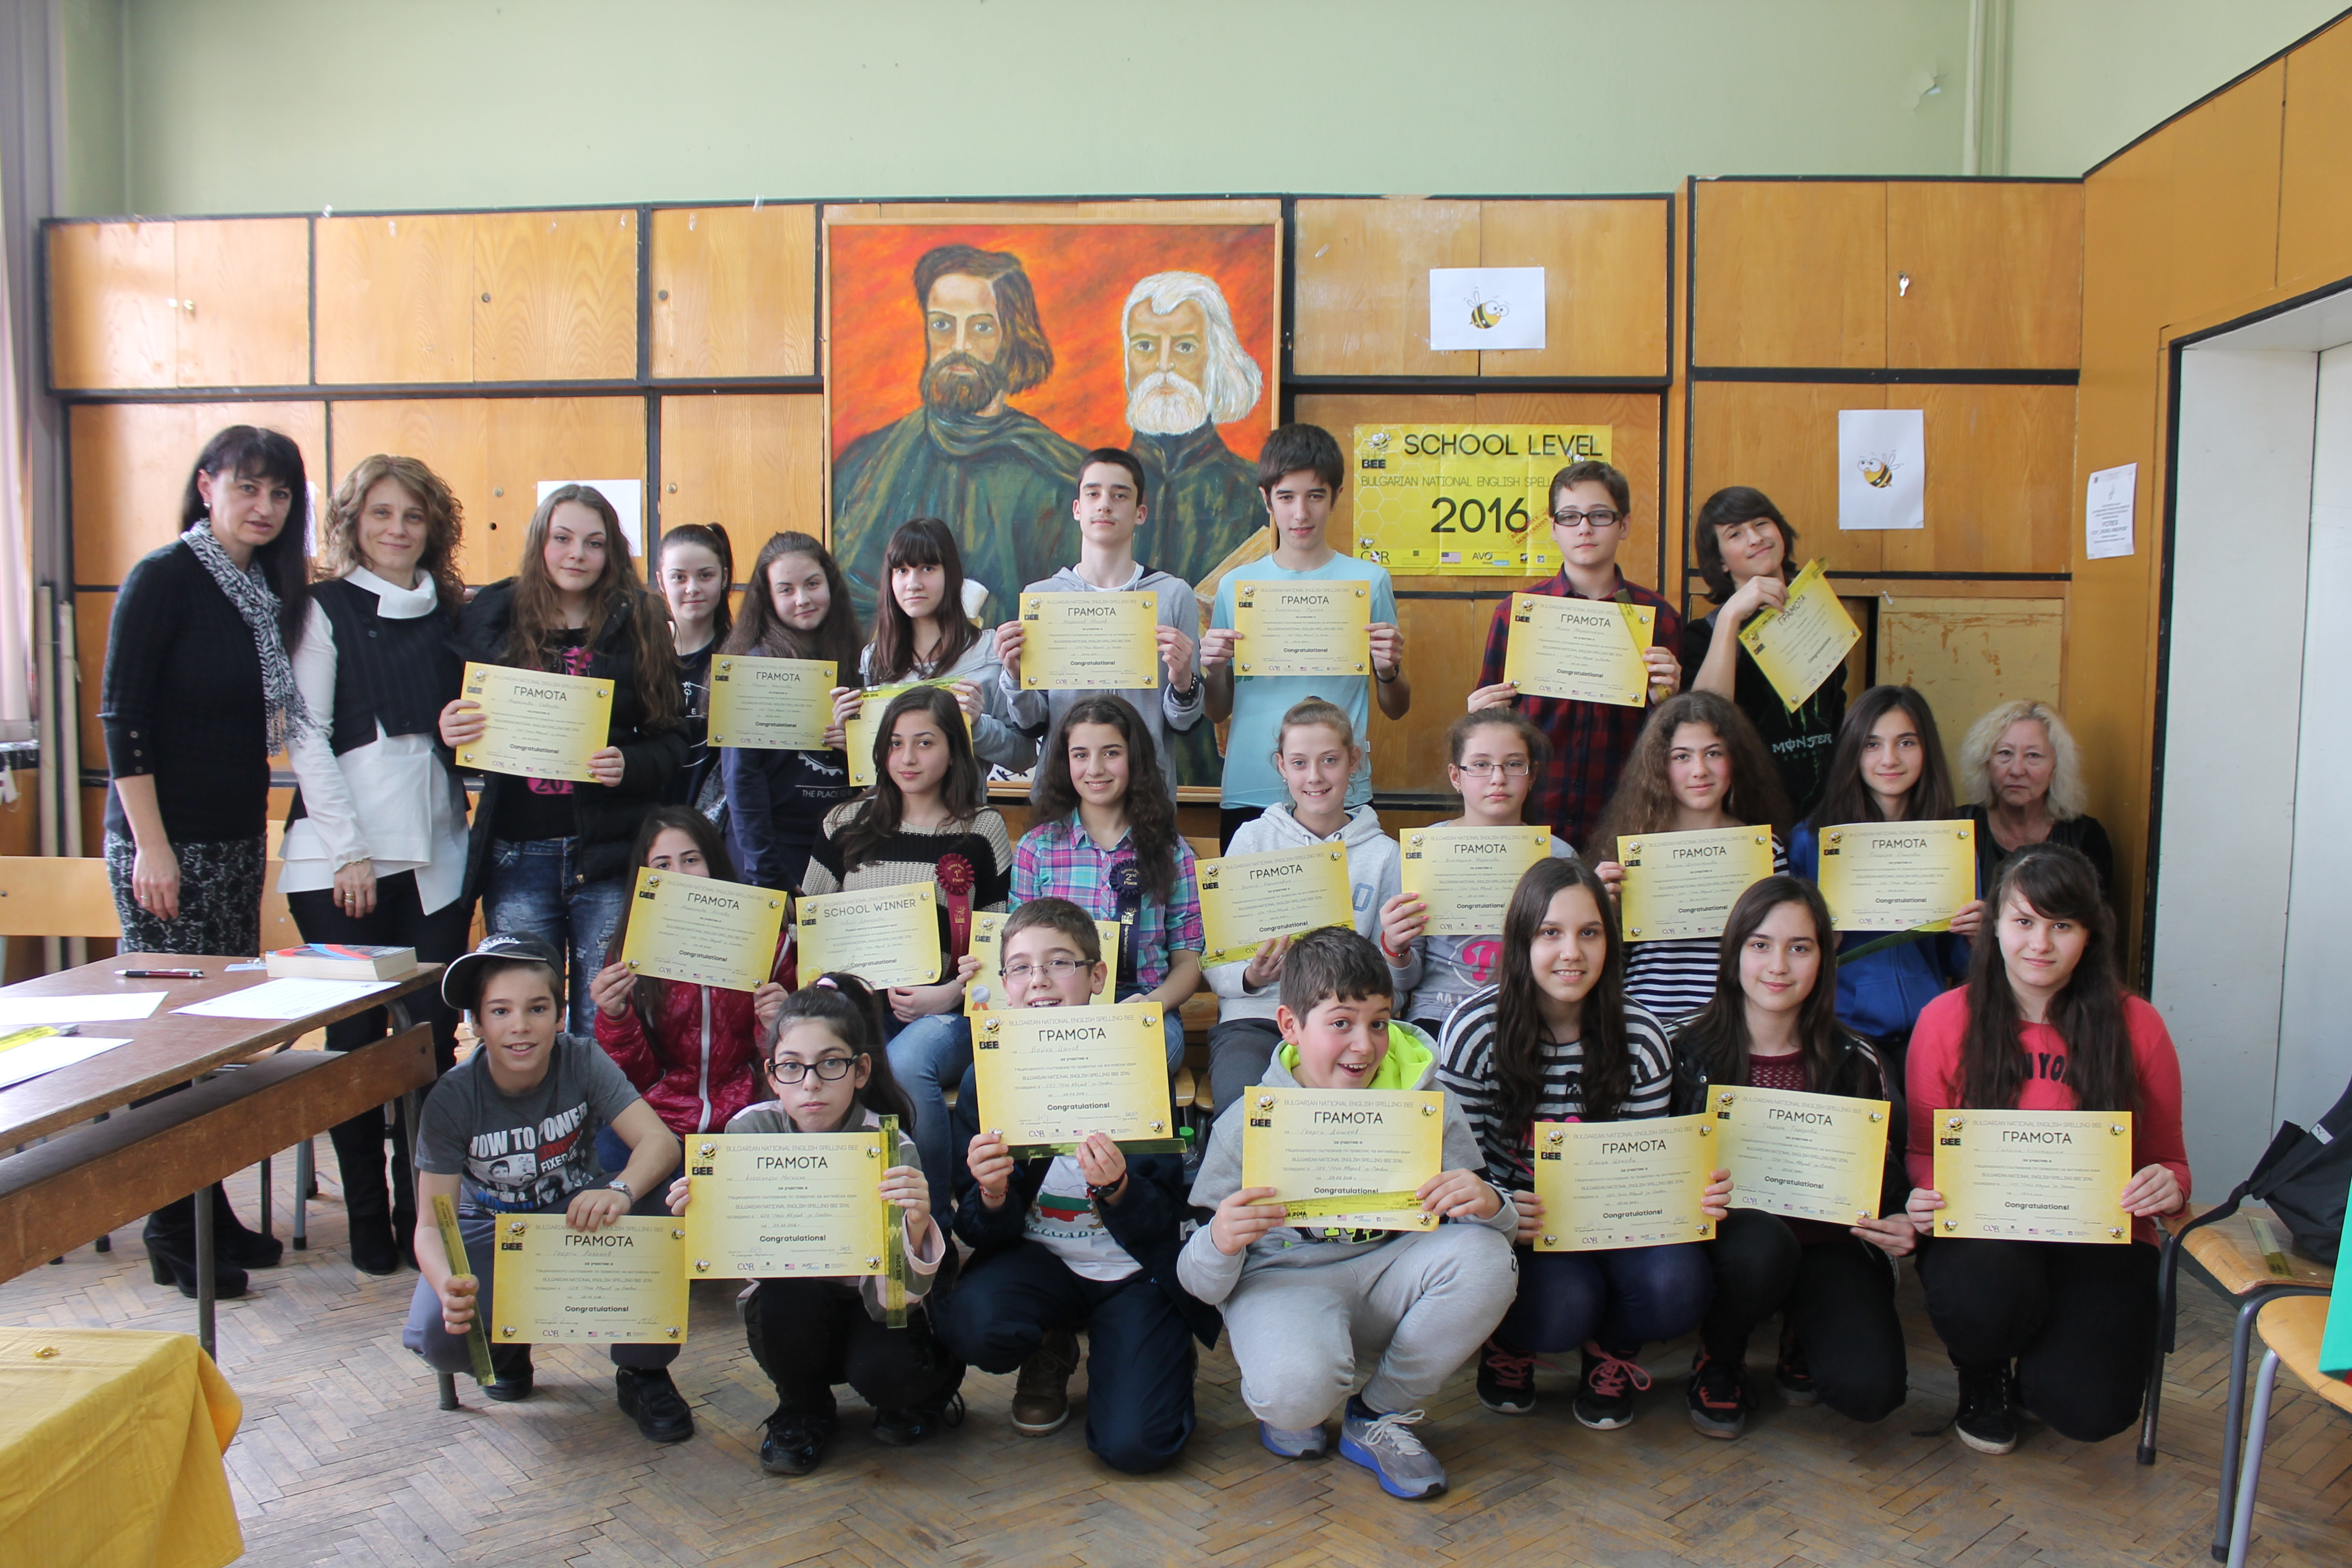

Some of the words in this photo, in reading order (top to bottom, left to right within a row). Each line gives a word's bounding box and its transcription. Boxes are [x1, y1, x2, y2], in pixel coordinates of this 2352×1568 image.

[1404, 433, 1518, 455] SCHOOL
[1528, 433, 1603, 456] LEVEL
[1362, 459, 1386, 469] BEE
[1361, 476, 1418, 487] BULGARIAN
[1423, 476, 1472, 487] NATIONAL
[1477, 476, 1520, 487] ENGLISH
[1525, 476, 1552, 487] SPELL
[1431, 497, 1529, 533] 2016
[1282, 596, 1329, 604] ГРАМОТА
[1068, 607, 1116, 616] ГРАМОТА
[1778, 592, 1807, 625] ГРАМОТА
[1560, 614, 1611, 627] ГРАМОТА
[756, 672, 801, 682] ГРАМОТА
[1556, 668, 1603, 679] Congratulations!
[514, 686, 567, 701] ГРАМОТА
[509, 743, 559, 755] Congratulations!
[1455, 843, 1507, 853] ГРАМОТА
[1872, 839, 1927, 848] ГРАМОТА
[1673, 846, 1727, 859] ГРАМОТА
[1249, 863, 1303, 879] ГРАМОТА
[1202, 882, 1218, 890] BEE
[639, 891, 655, 899] BEE
[687, 892, 741, 910] ГРАМОТА
[824, 904, 870, 918] SCHOOL
[873, 898, 916, 912] WINNER
[1678, 904, 1728, 914] Congratulations!
[1259, 920, 1308, 933] Congratulations!
[678, 949, 727, 963] Congratulations!
[851, 958, 897, 968] Congratulations!
[1038, 1027, 1106, 1042] ГРАМОТА
[978, 1041, 999, 1049] BEE
[1047, 1102, 1109, 1112] Congratulations!
[1314, 1112, 1384, 1124] ГРАМОТА
[1769, 1108, 1833, 1126] ГРАМОТА
[1251, 1119, 1272, 1128] BEE
[469, 1130, 508, 1158] HOW
[510, 1126, 536, 1151] TO
[2002, 1131, 2072, 1144] ГРАМОТА
[1602, 1139, 1667, 1154] ГРАМОТА
[1540, 1152, 1561, 1161] BEE
[757, 1156, 828, 1169] ГРАМОТА
[692, 1167, 713, 1175] BEE
[1764, 1175, 1824, 1190] Congratulations!
[1314, 1186, 1378, 1195] Congratulations!
[2005, 1201, 2069, 1211] Congratulations!
[1603, 1208, 1662, 1220] Congratulations!
[565, 1235, 634, 1246] ГРАМОТА
[759, 1234, 825, 1243] Congratulations!
